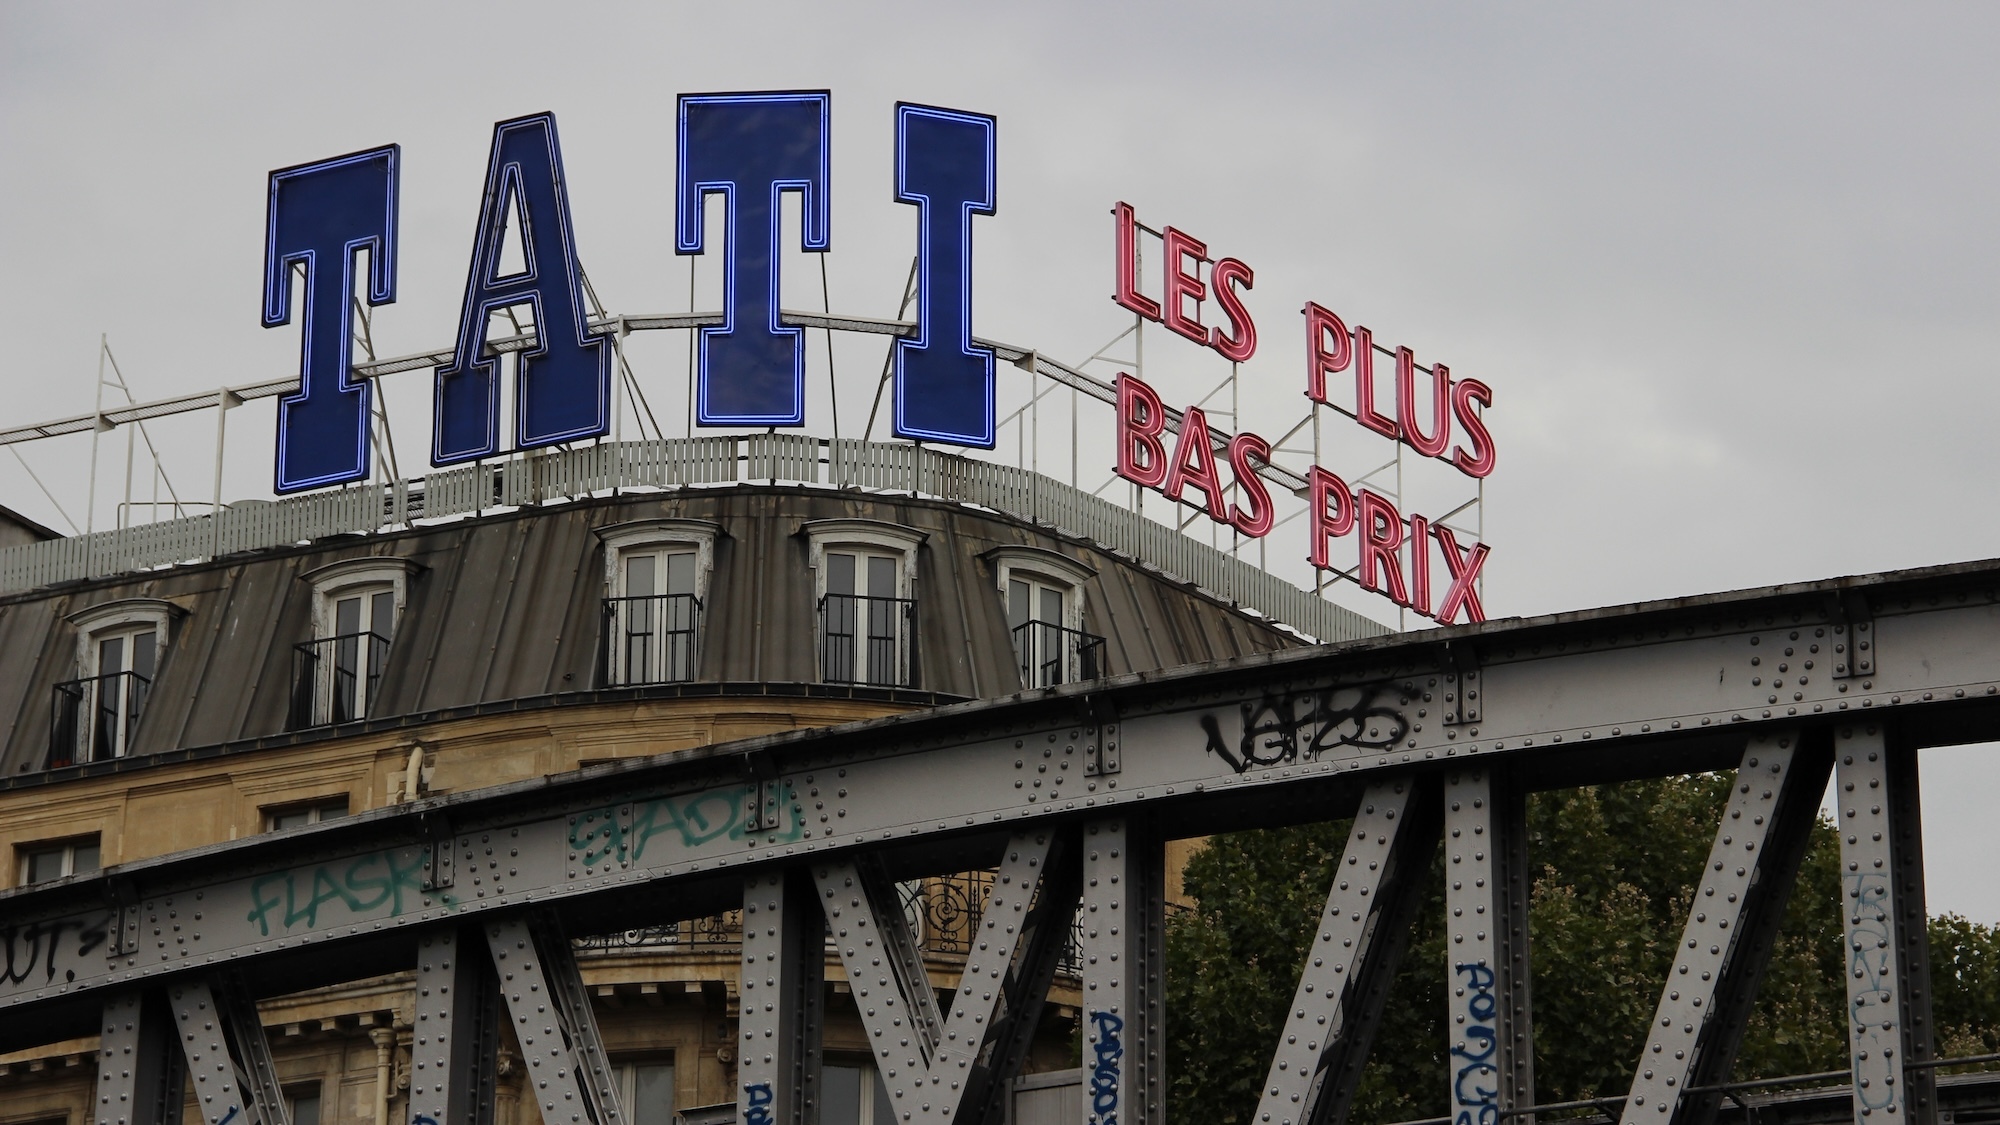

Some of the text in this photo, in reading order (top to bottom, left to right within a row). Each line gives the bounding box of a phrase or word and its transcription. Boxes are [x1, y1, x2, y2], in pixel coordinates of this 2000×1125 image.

[262, 89, 997, 495] TATI
[1115, 201, 1496, 479] LES PLUS
[1116, 372, 1491, 626] BAS PRIX
